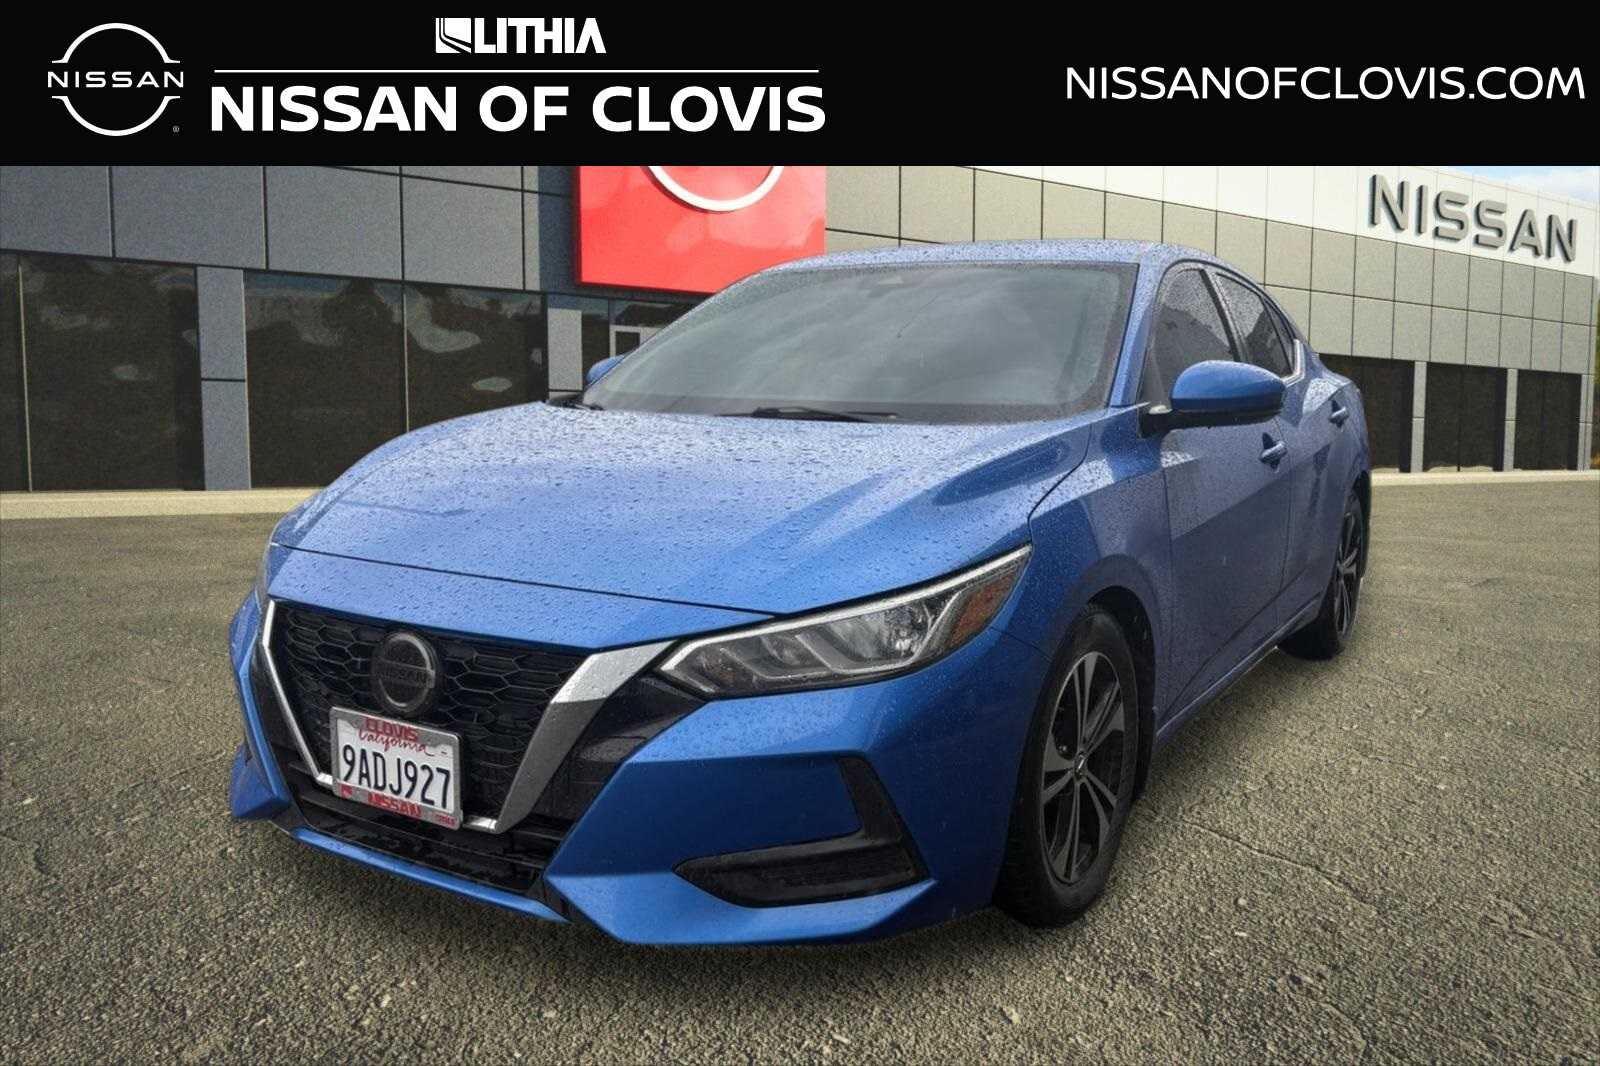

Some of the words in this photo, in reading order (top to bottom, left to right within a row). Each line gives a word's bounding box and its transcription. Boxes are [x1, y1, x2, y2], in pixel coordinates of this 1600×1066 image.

[1369, 174, 1577, 263] NISSAN
[342, 744, 451, 809] 9ADJ927
[368, 792, 422, 818] NISSAN
